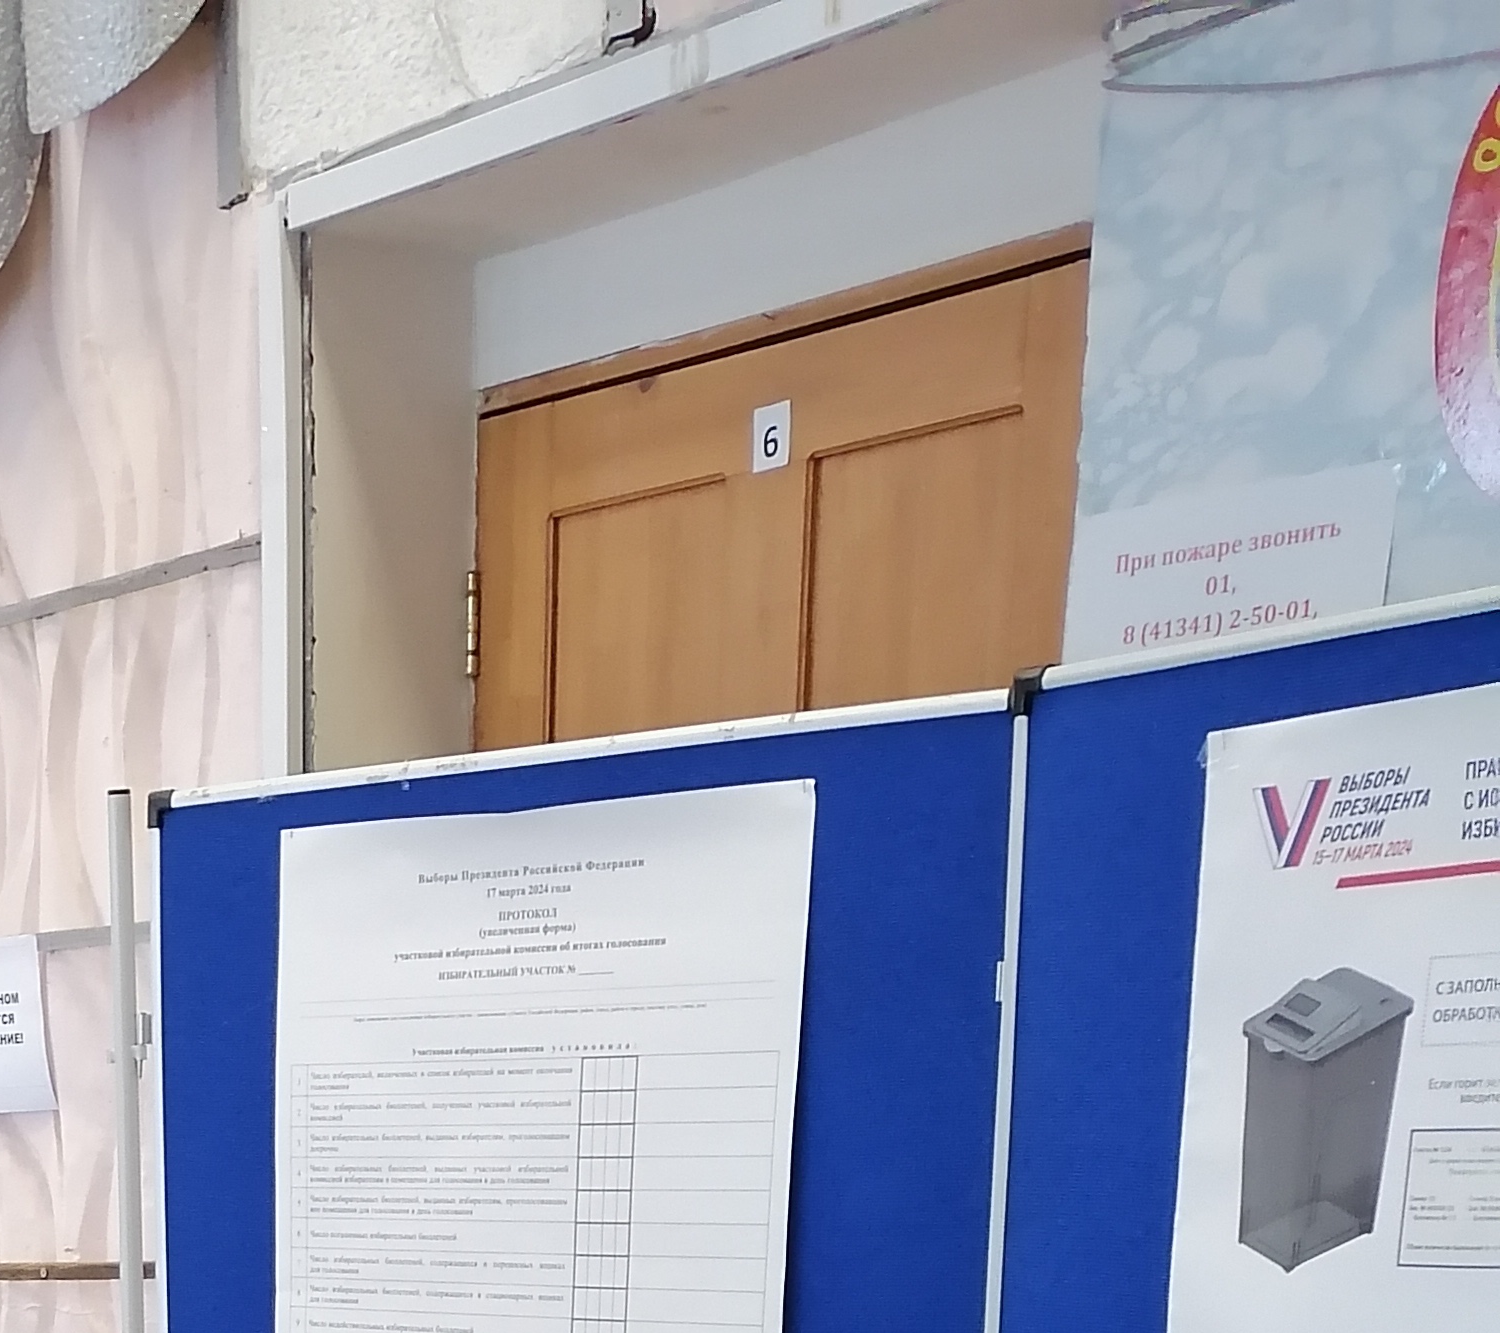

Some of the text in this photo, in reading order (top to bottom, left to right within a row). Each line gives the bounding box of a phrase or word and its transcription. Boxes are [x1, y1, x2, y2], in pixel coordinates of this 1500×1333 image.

[763, 425, 779, 458] 6
[1115, 522, 1342, 577] При пожаре звонить
[1205, 574, 1237, 596] 01,
[1122, 598, 1318, 647] 8 (41341) 2-50-01,
[1337, 765, 1412, 795] ВЫБОРЫ
[1465, 757, 1500, 781] ПРА
[1328, 788, 1431, 820] ПРЕЗИДЕНТА
[1463, 790, 1475, 811] С
[1319, 818, 1386, 845] РОССИИ
[1344, 844, 1383, 865] МАРТА
[1383, 838, 1414, 859] 2024
[417, 857, 646, 885] Выборы Президента Российской Федерации
[486, 883, 572, 900] 17 марта 2024 года
[498, 907, 558, 922] ПРОТОКОЛ
[478, 921, 577, 940] (увеличенная форма)
[445, 945, 512, 961] избирательной
[605, 936, 667, 950] голосования
[519, 964, 566, 977] УЧАСТОК
[1435, 981, 1446, 995] С
